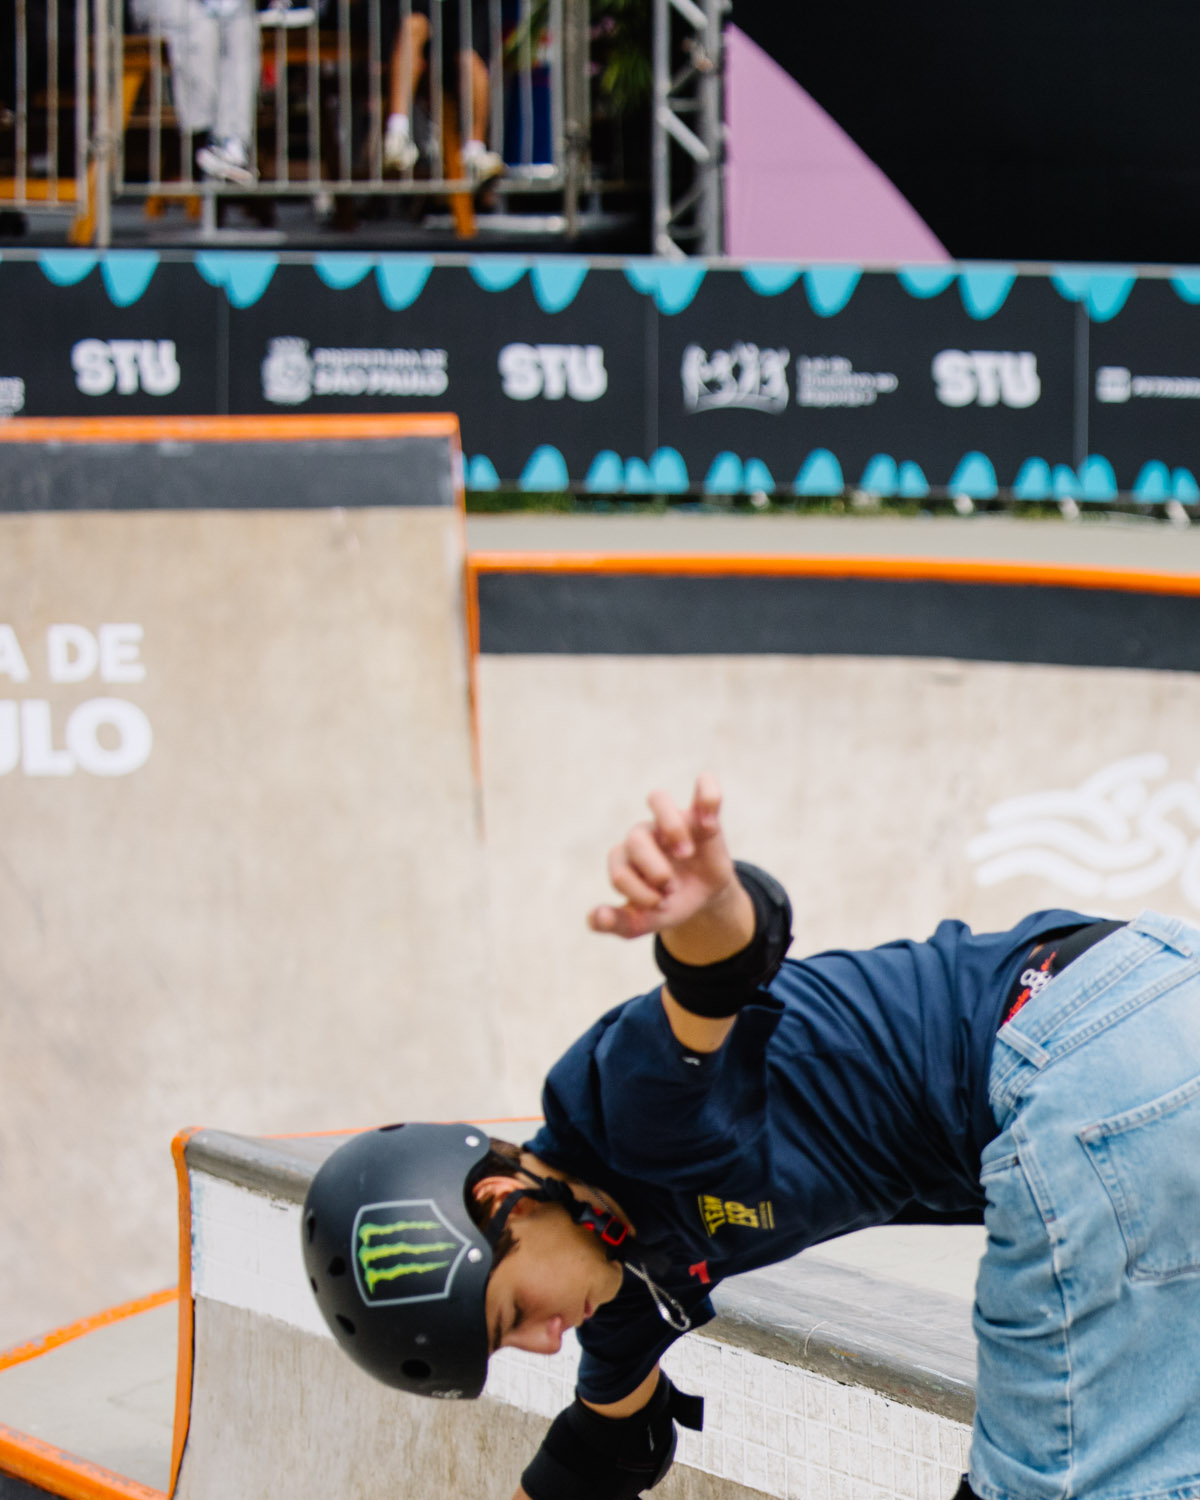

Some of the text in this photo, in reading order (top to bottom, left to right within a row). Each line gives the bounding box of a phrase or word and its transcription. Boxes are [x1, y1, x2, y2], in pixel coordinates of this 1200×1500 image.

[70, 338, 181, 396] STU
[498, 342, 608, 401] STU
[931, 349, 1041, 409] STU
[47, 623, 146, 683] DE
